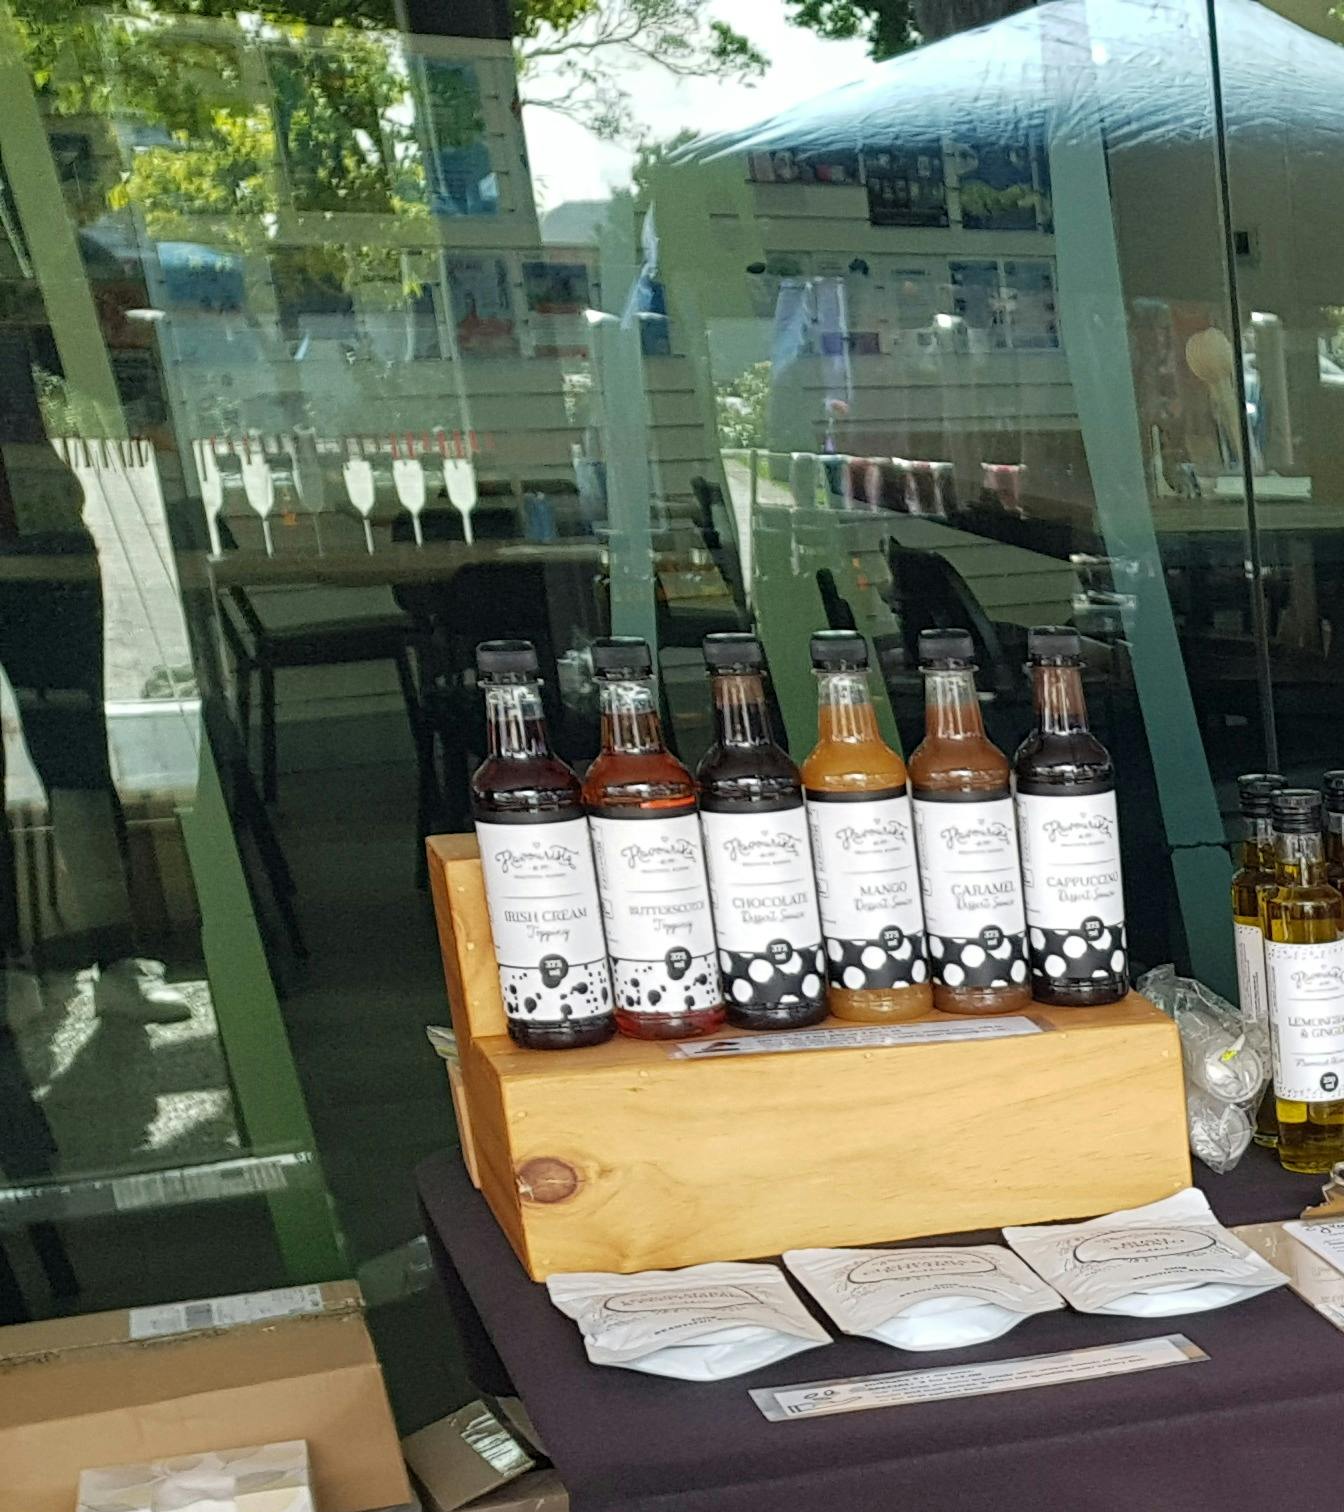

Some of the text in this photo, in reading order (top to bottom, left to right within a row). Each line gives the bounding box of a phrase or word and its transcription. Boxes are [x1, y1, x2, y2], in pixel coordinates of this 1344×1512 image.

[860, 881, 907, 896] MANGO
[951, 880, 1015, 896] CARAMEL
[504, 907, 588, 922] IRISH CREAM
